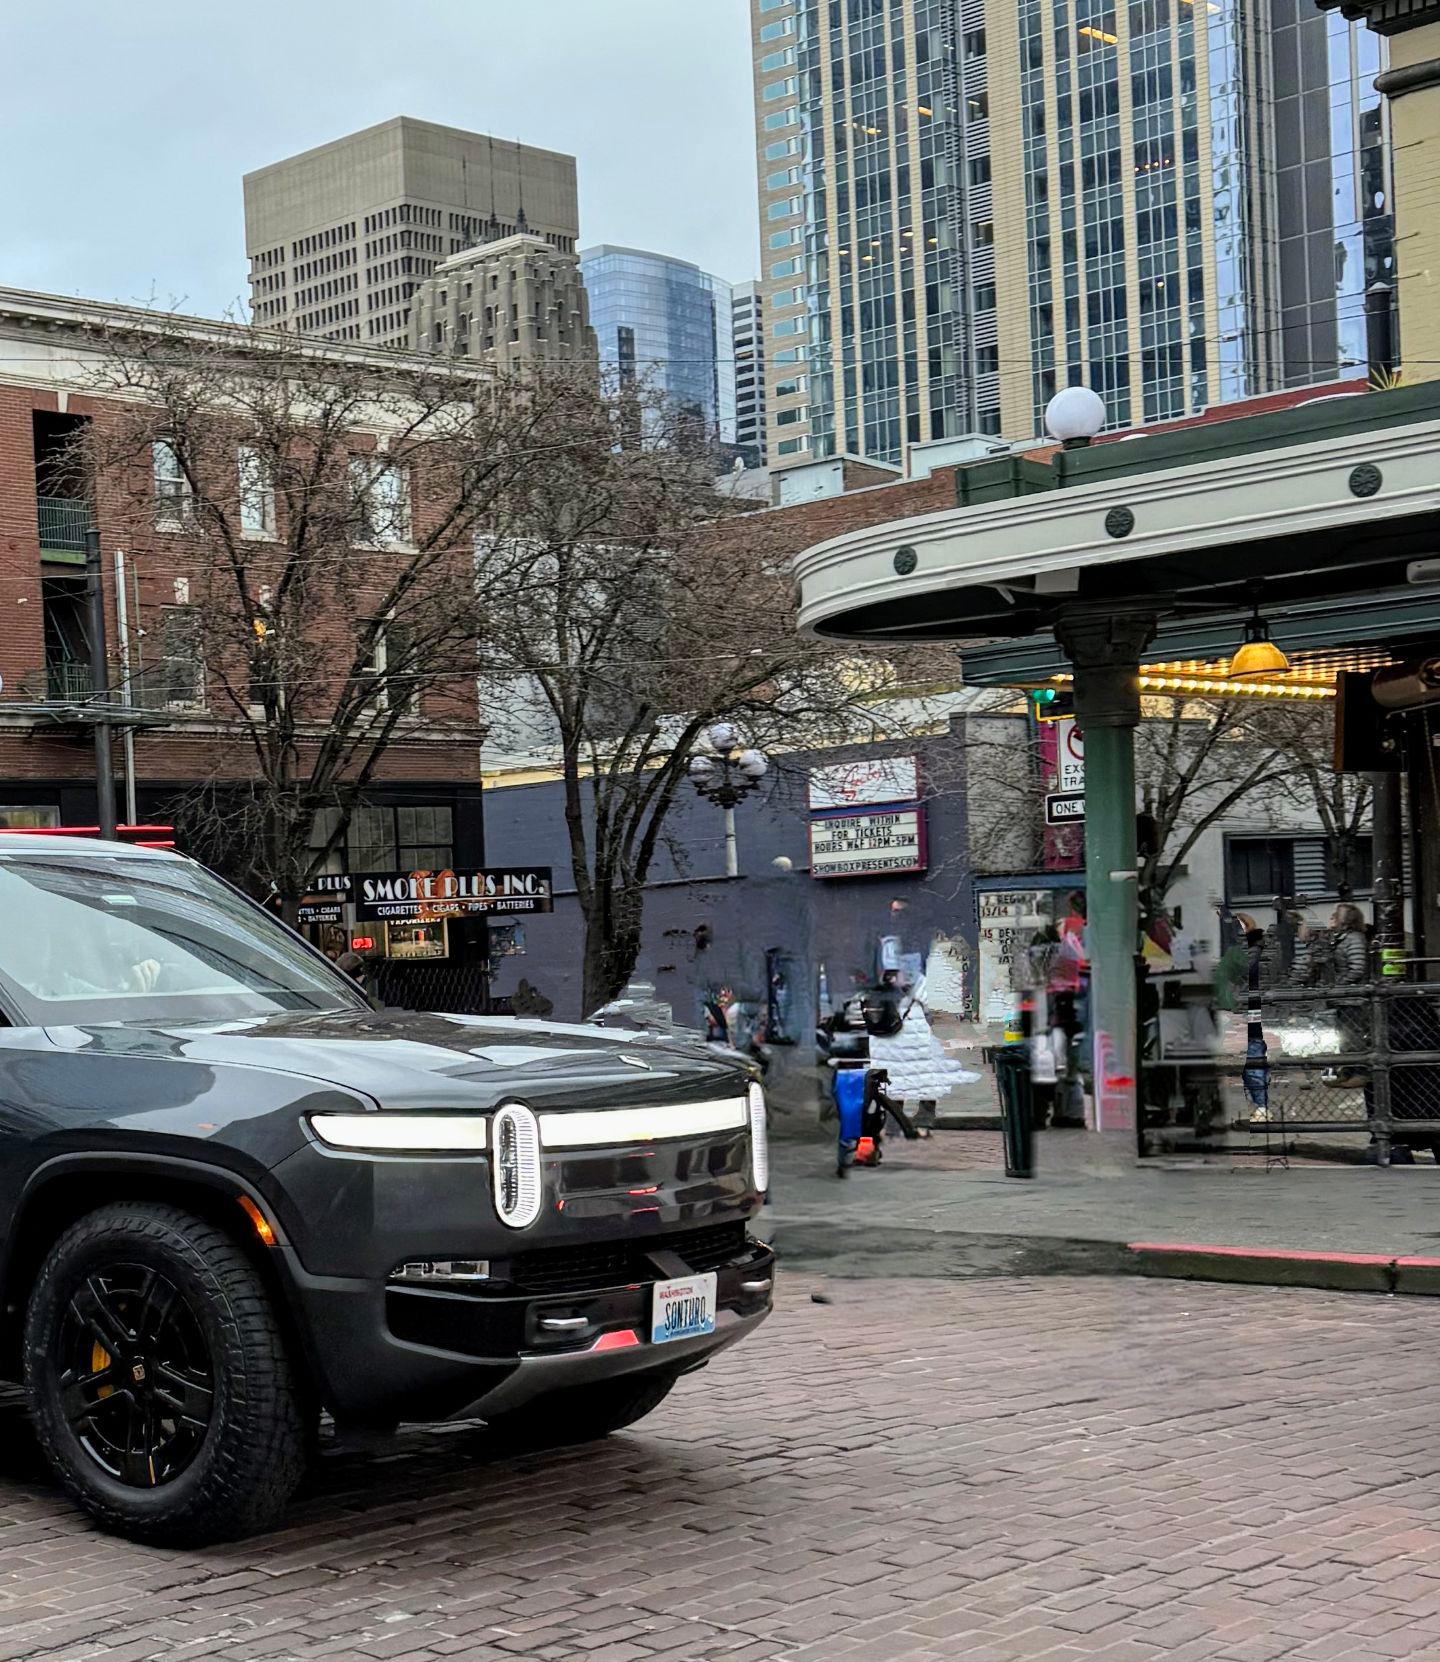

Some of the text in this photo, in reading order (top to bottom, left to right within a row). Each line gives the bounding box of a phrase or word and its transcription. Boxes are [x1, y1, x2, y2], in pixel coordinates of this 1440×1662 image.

[1056, 802, 1078, 815] ONE
[824, 815, 901, 830] INQUIRE WITHIN
[831, 826, 892, 840] FOR TICKETS
[814, 841, 843, 852] HOURS
[868, 836, 915, 849] 12PM-5PM
[317, 875, 351, 891] PLUS
[363, 873, 544, 901] SMOKE PLUS INC.
[377, 900, 534, 916] CIGARETTES CIGARS PIPES BATTERIES
